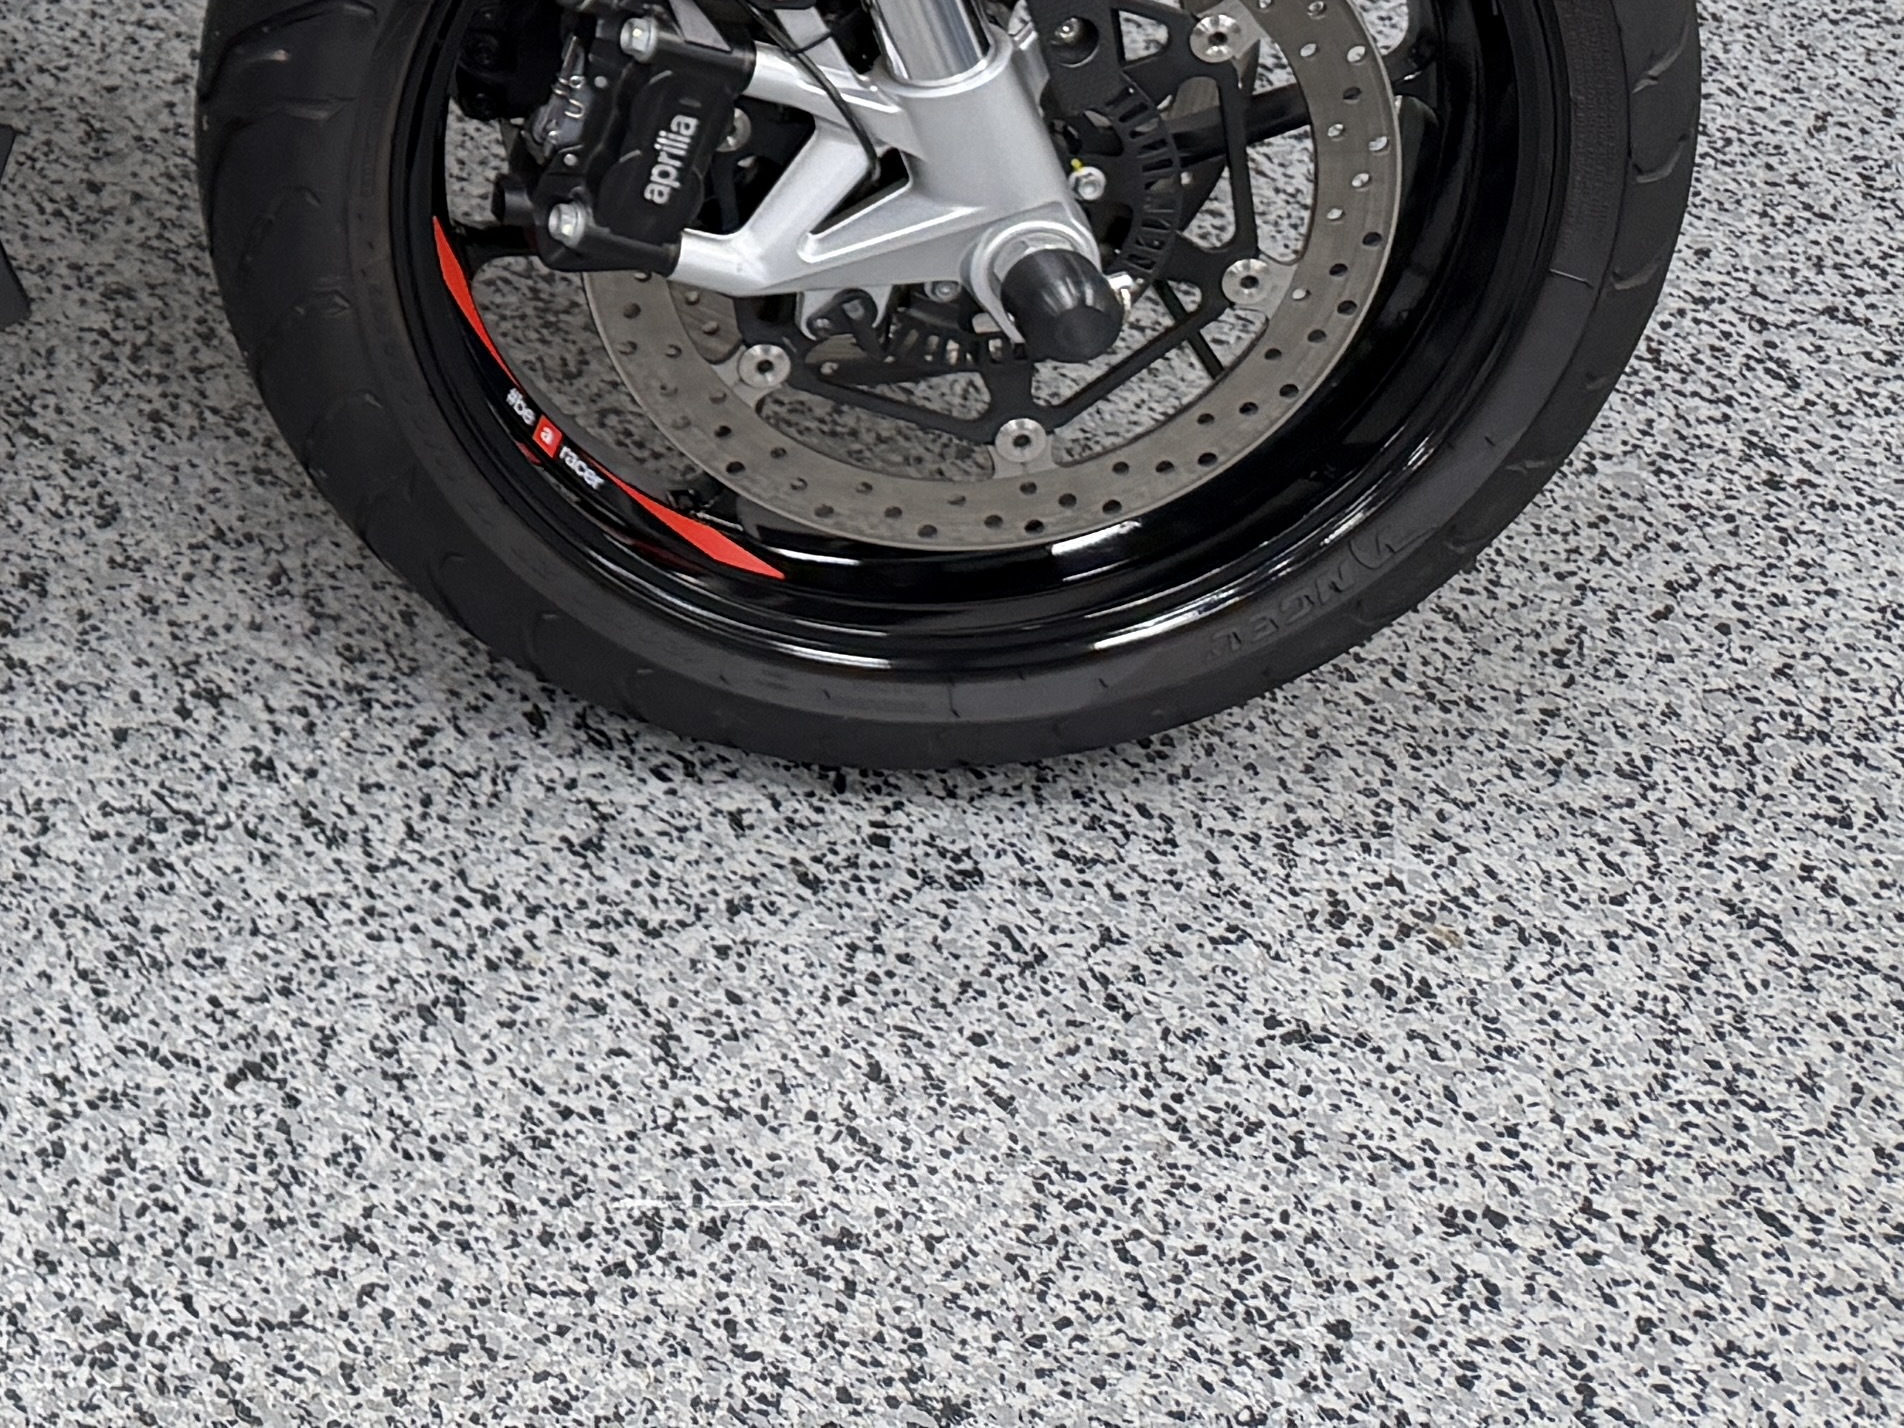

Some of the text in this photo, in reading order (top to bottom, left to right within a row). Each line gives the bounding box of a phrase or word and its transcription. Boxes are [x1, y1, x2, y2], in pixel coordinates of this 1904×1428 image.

[644, 114, 699, 204] aprilia
[505, 387, 536, 426] #be
[559, 446, 605, 490] racer
